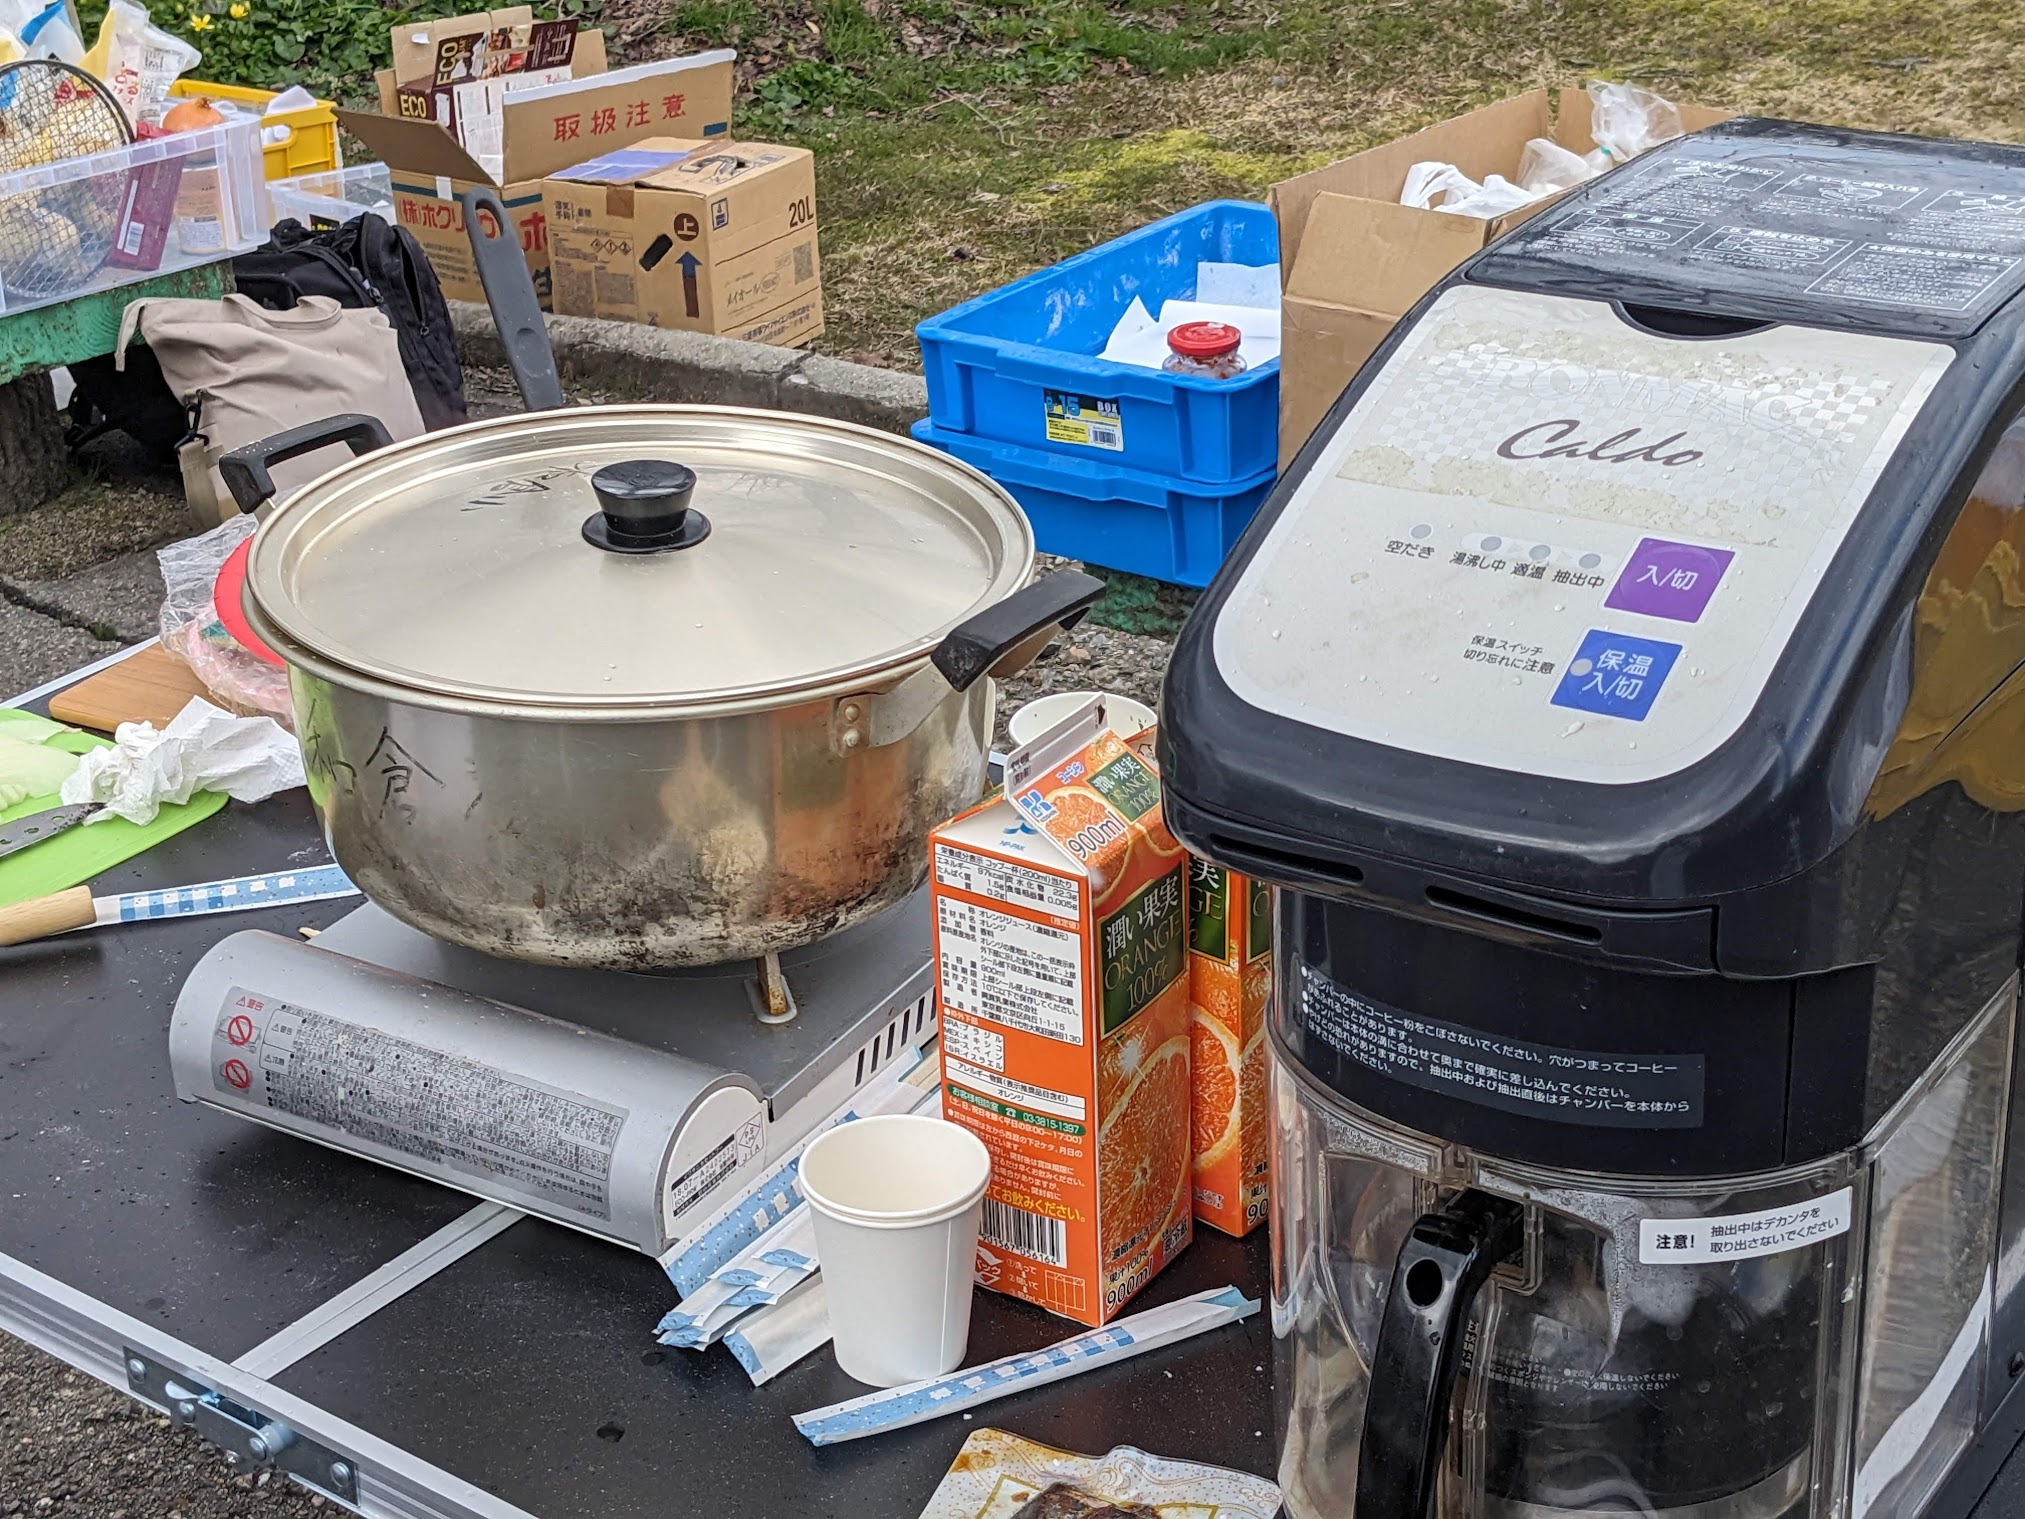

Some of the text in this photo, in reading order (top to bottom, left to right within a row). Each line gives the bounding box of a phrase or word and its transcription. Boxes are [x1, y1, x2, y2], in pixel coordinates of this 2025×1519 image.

[436, 41, 458, 86] ECO
[400, 94, 427, 119] ECO
[553, 93, 686, 142] 取扱注意
[788, 195, 814, 229] 20L
[678, 217, 697, 236] 上
[1096, 400, 1119, 414] BOX
[1498, 419, 1705, 467] Caldo
[1385, 540, 1435, 560] 空だき
[1449, 550, 1605, 589] 湯沸し中 適温 抽出中
[1636, 564, 1699, 591] 入/切
[1471, 635, 1544, 658] 保温スイッチ
[1463, 648, 1556, 675] 切り忘れに注意
[1596, 649, 1655, 677] 保温
[1582, 671, 1644, 700] 入/切
[1069, 811, 1126, 859] 900ml
[937, 857, 971, 870] エネルギー
[937, 865, 972, 881] たんぱく質
[980, 920, 1007, 932] オレンジ
[1106, 875, 1179, 959] 潤い果実
[1104, 909, 1182, 991] ORANGE
[1126, 955, 1169, 1013] 100%
[246, 998, 265, 1012] 警告
[1307, 983, 1413, 1043] があふれることがあります。
[1308, 1019, 1393, 1074] はずさないでください。
[1308, 996, 1631, 1099] チャンバーは本体の溝に合わせて奥まで確実に差し込んでください。
[998, 1089, 1025, 1102] オレンジ
[1022, 1112, 1080, 1135] 03-3815-1397
[742, 1144, 760, 1163] JIA
[1709, 1217, 1840, 1254] 取り出さないでください
[1710, 1207, 1821, 1238] 抽出中はデカンタを
[1020, 1247, 1057, 1265] 056164
[1656, 1234, 1696, 1250] 注意!
[1106, 1257, 1154, 1312] 900ml
